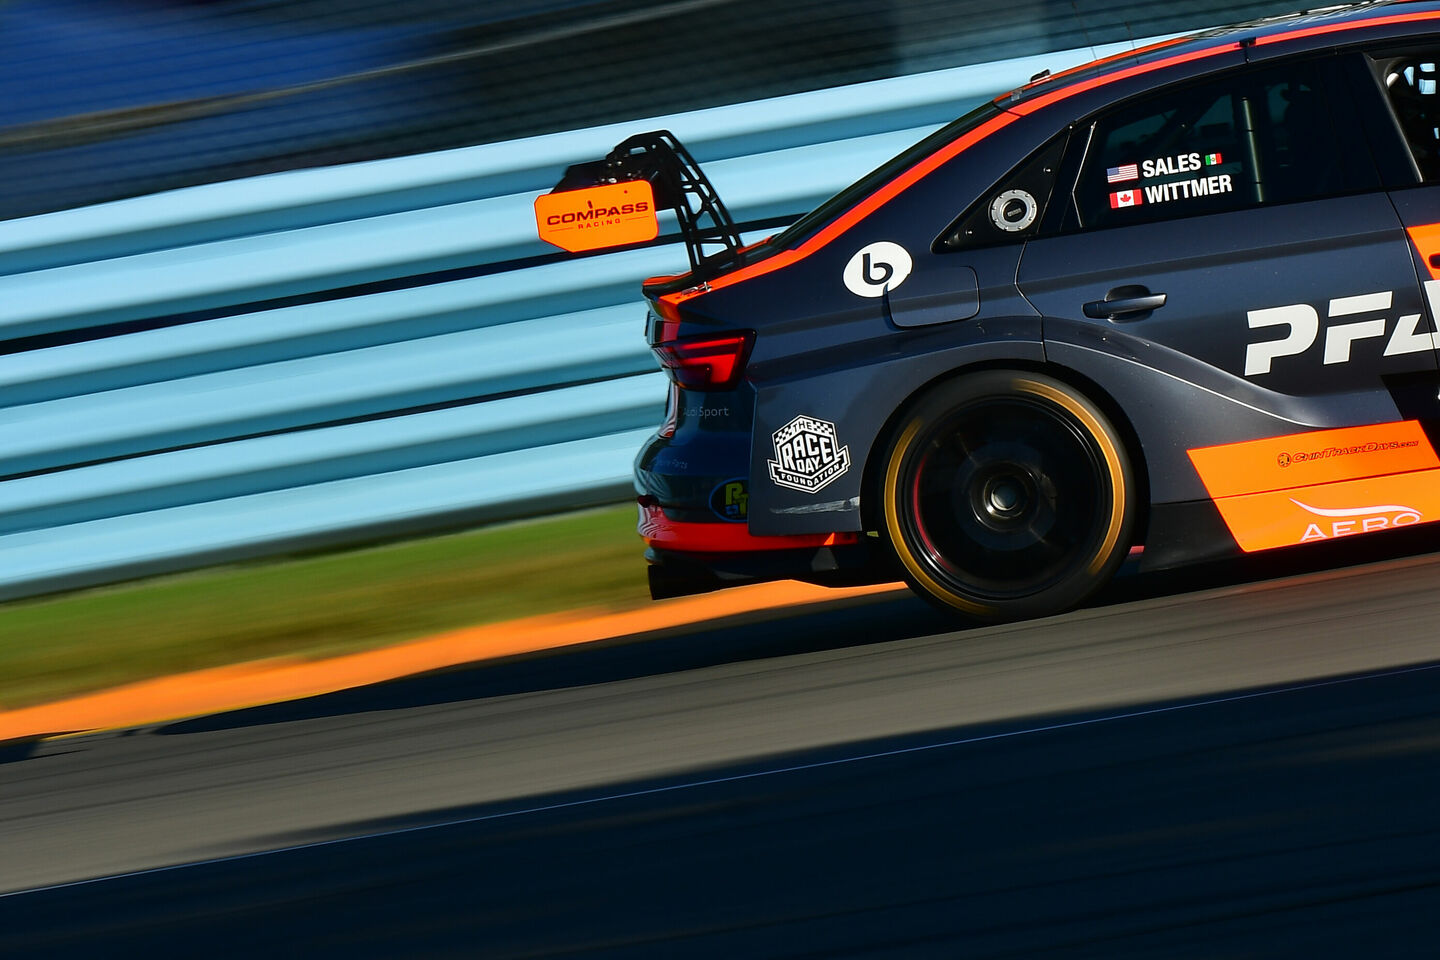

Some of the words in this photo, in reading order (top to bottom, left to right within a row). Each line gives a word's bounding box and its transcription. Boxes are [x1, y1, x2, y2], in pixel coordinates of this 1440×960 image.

[1142, 152, 1202, 179] SALES
[1145, 174, 1233, 204] WITTMER
[547, 201, 649, 226] COMPASS
[578, 218, 621, 230] RACING
[699, 406, 730, 420] Sport
[793, 420, 813, 432] THE
[781, 433, 833, 471] RACE
[780, 463, 840, 487] FOUNDATION
[796, 456, 820, 474] DAY
[1300, 512, 1421, 541] AERO
